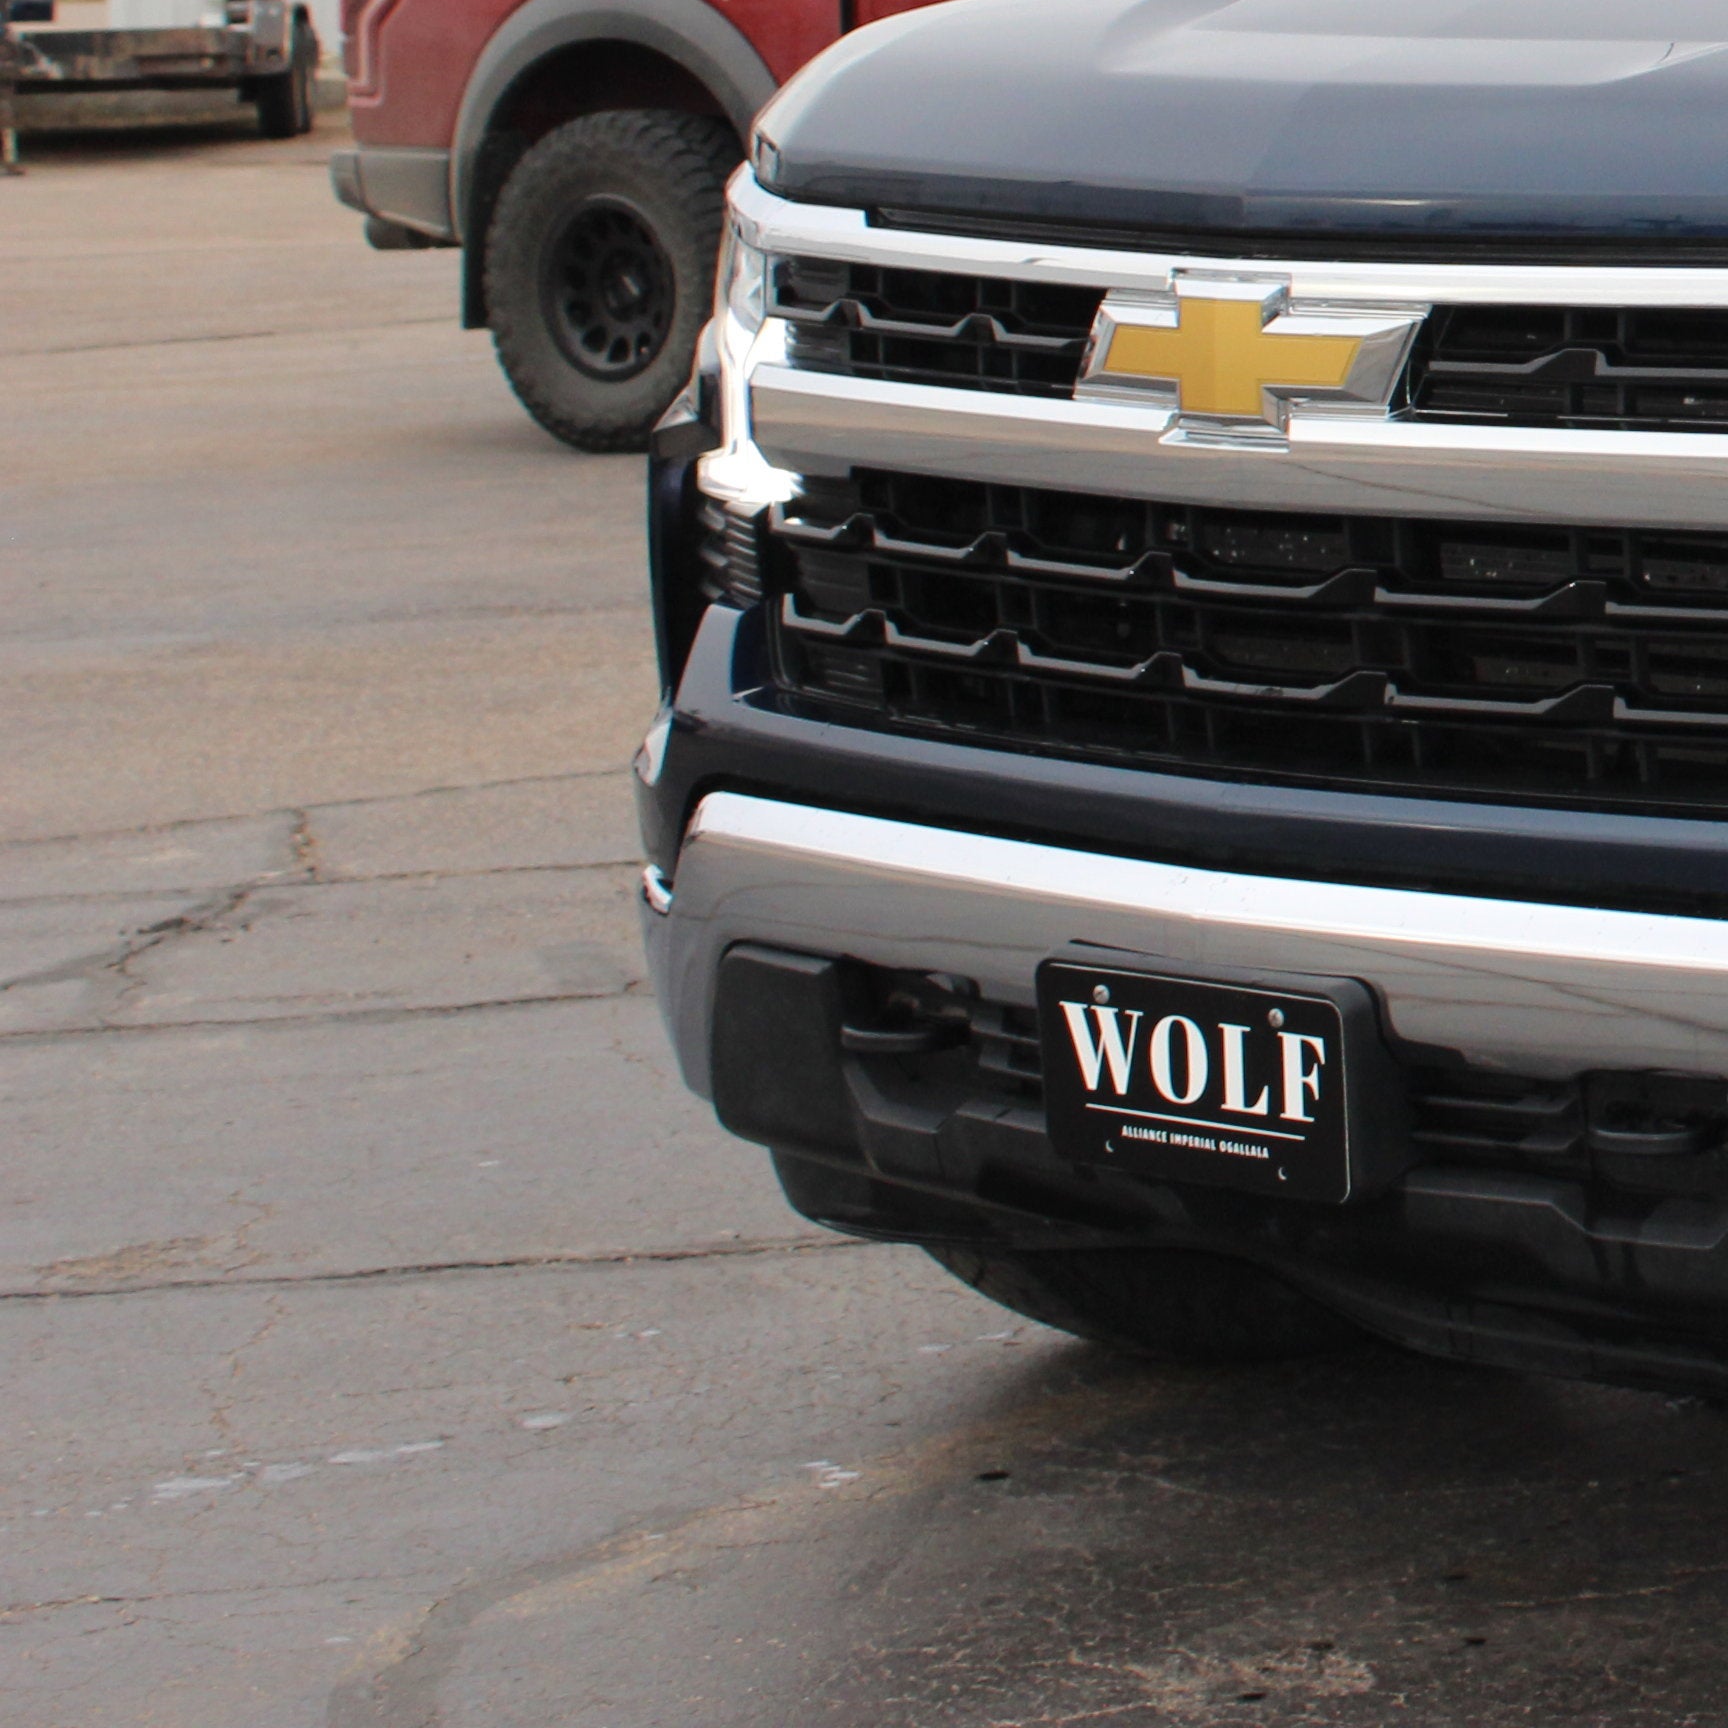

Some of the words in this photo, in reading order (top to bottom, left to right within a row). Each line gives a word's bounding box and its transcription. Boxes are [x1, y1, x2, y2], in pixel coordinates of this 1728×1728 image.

[1058, 1000, 1326, 1122] WOLF
[1121, 1125, 1168, 1144] ALLIANCE
[1169, 1132, 1216, 1151] IMPERIAL
[1219, 1140, 1269, 1159] OGALLALA
